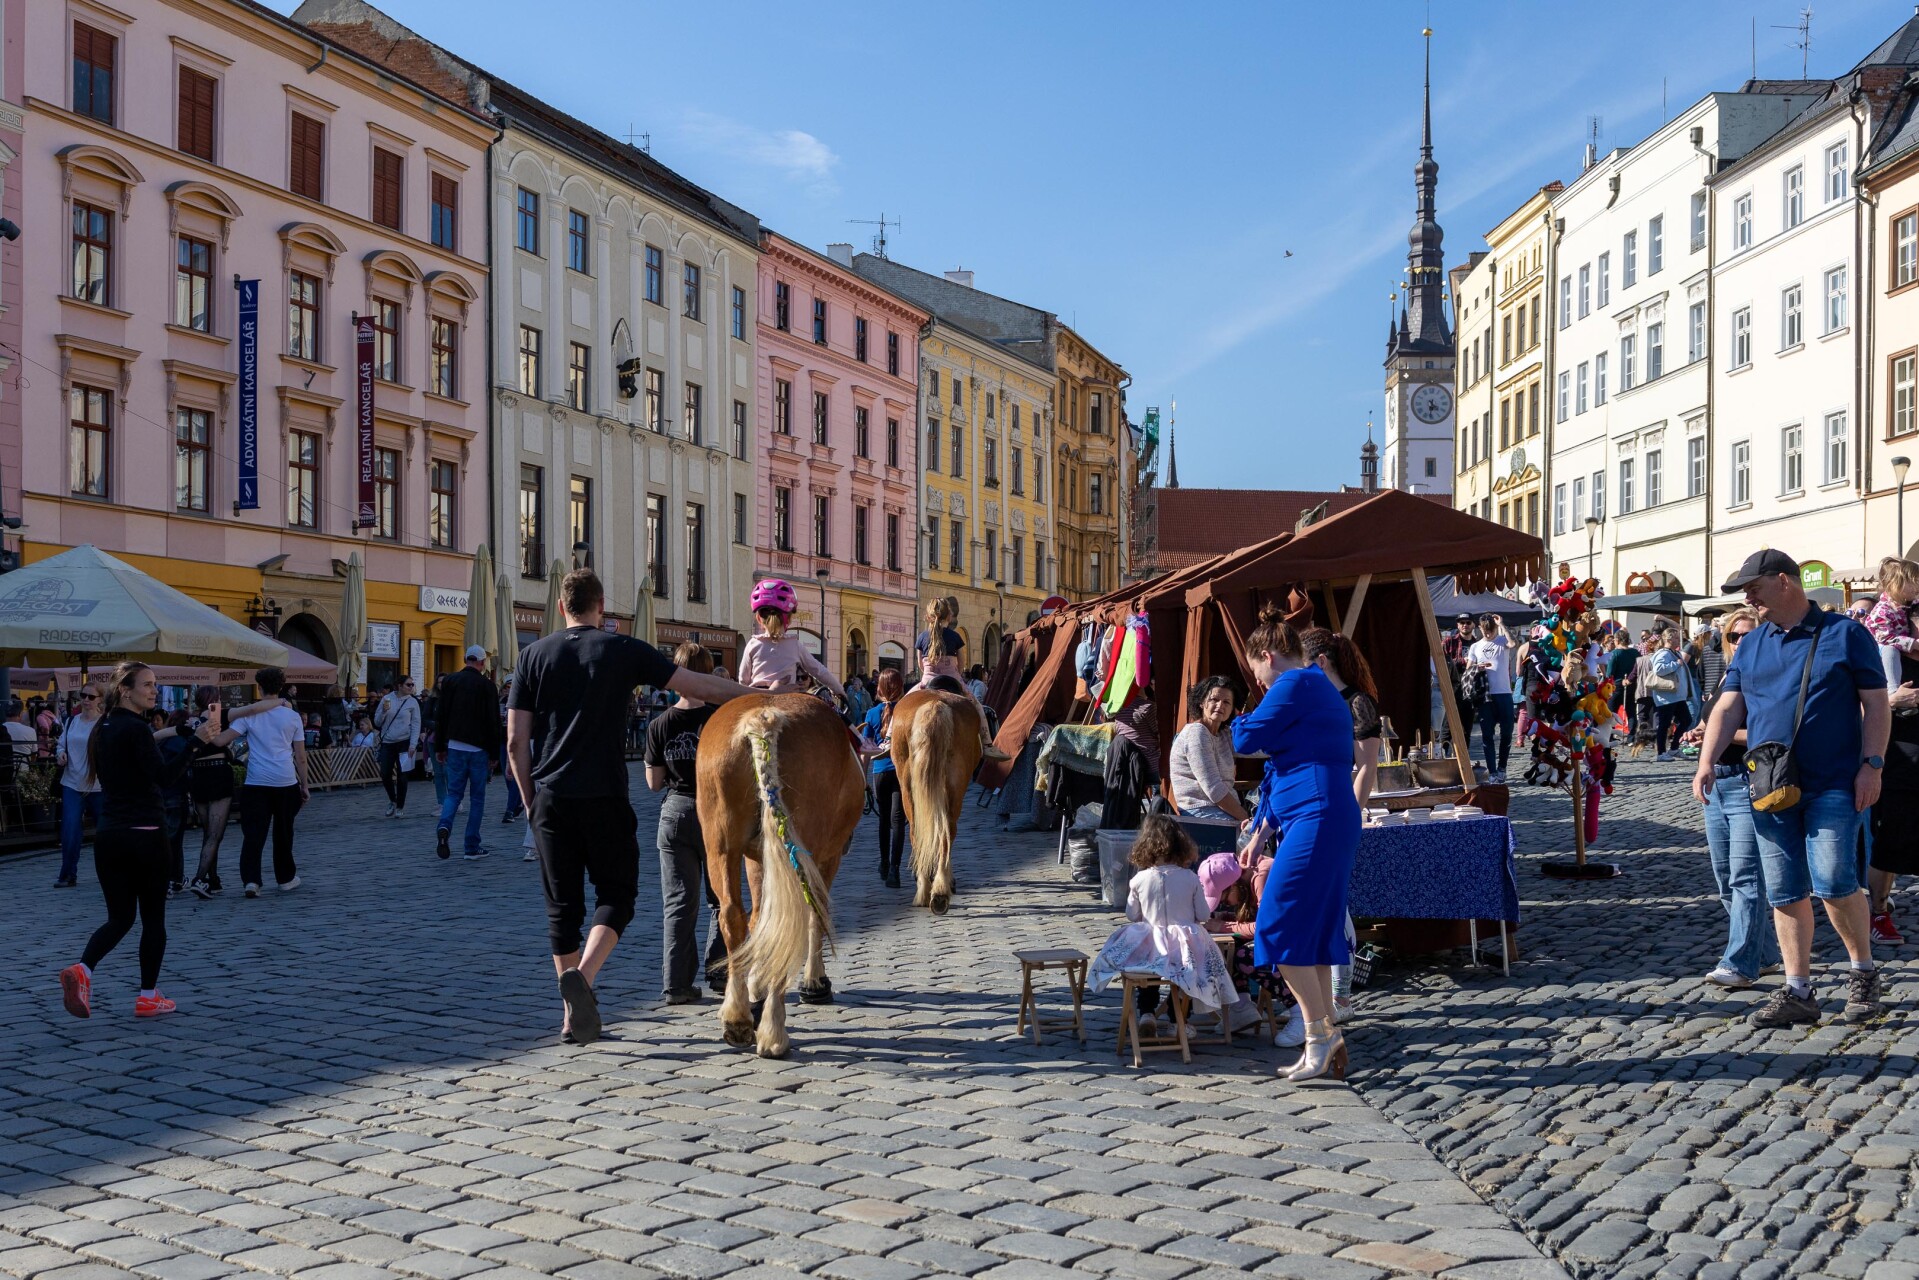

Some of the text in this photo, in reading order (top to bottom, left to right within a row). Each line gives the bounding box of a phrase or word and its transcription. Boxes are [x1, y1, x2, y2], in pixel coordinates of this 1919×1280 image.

[242, 321, 255, 390] KANCELÁŘ
[242, 394, 255, 468] ADVOKÁTNÍ
[360, 362, 371, 483] REALITNÍ KANCELÁŘ
[1803, 568, 1823, 583] Grunt
[0, 600, 89, 615] DEGAST
[436, 594, 458, 610] GREEK
[515, 611, 544, 625] KÁRNA
[39, 628, 116, 647] RADEGAST
